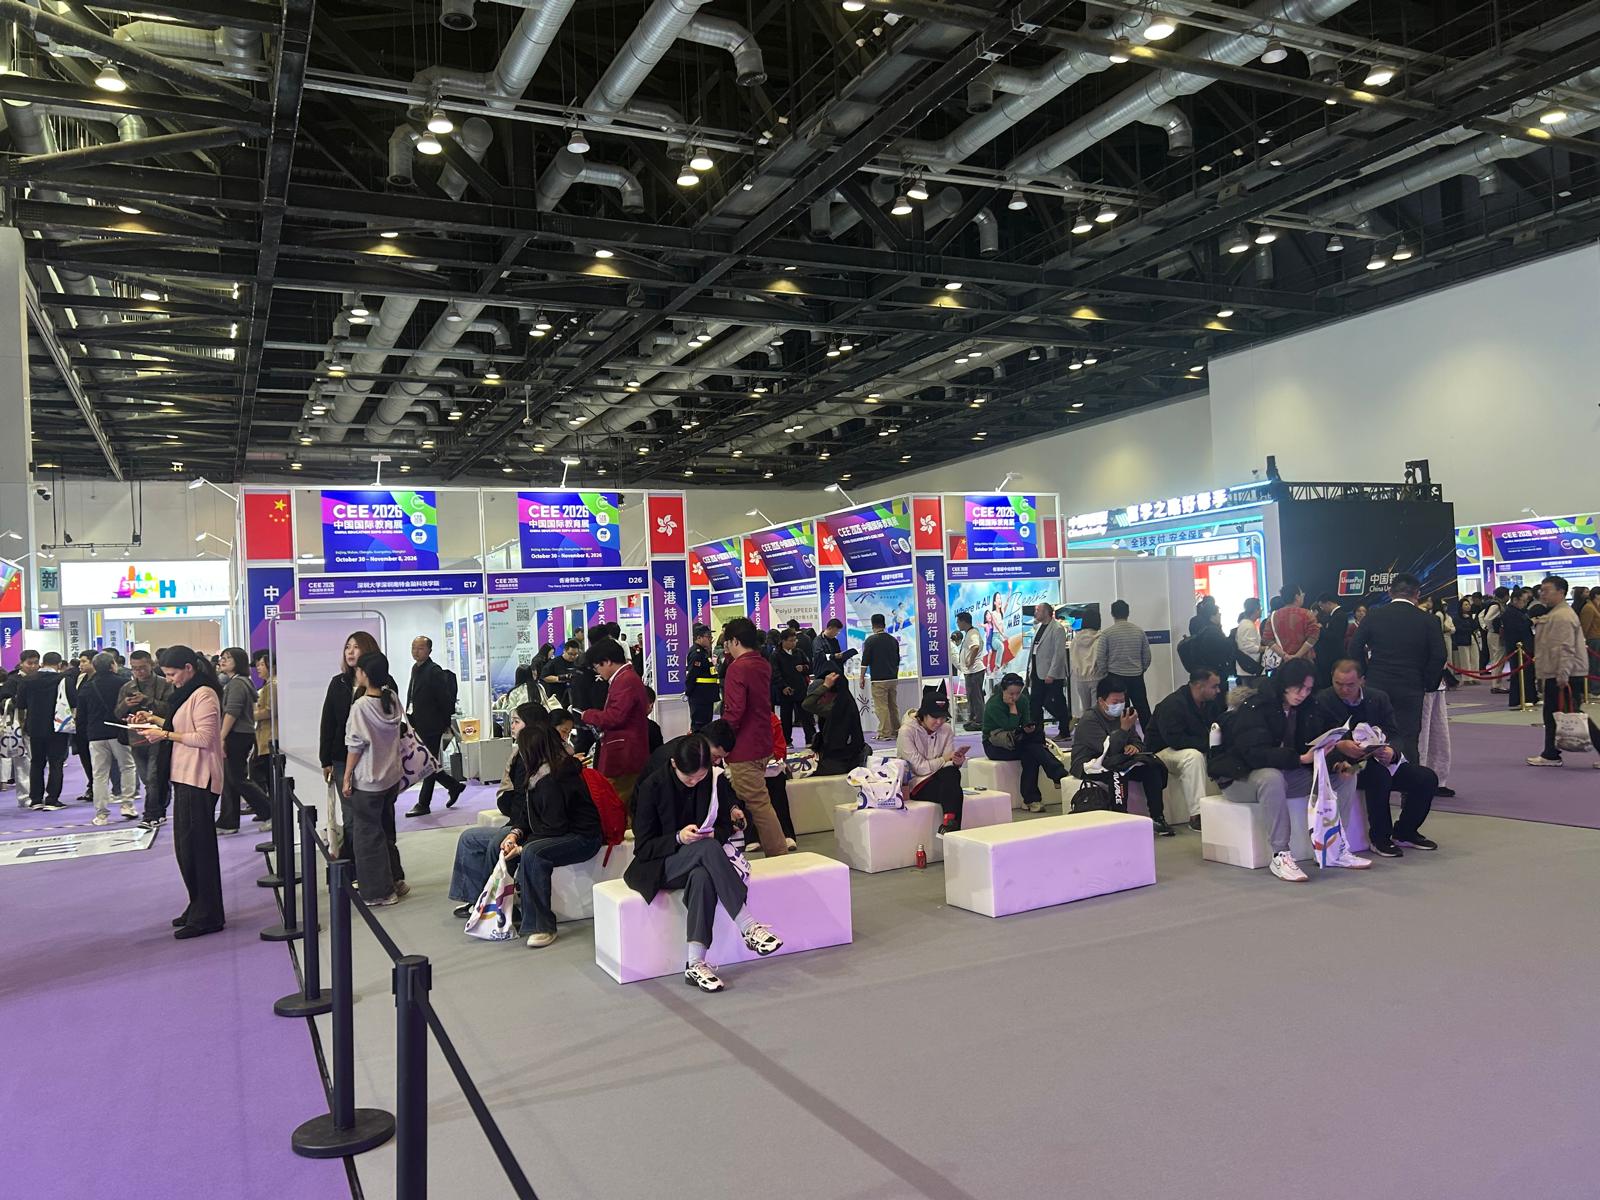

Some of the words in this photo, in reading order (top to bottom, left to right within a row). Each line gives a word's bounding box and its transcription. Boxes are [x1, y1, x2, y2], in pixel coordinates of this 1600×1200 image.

[333, 505, 369, 518] CEE
[372, 505, 403, 518] 2026
[528, 505, 560, 518] CEE
[562, 505, 589, 518] 2026
[972, 507, 994, 518] CEE
[996, 507, 1015, 517] 2026
[334, 520, 403, 530] 中国国际教育展
[528, 520, 590, 528] 中国国际教育展
[837, 527, 851, 537] CEE
[42, 571, 58, 589] 新
[264, 585, 280, 620] 中国
[924, 570, 940, 666] 香港特别行政区
[663, 576, 680, 682] 香港特别行政区
